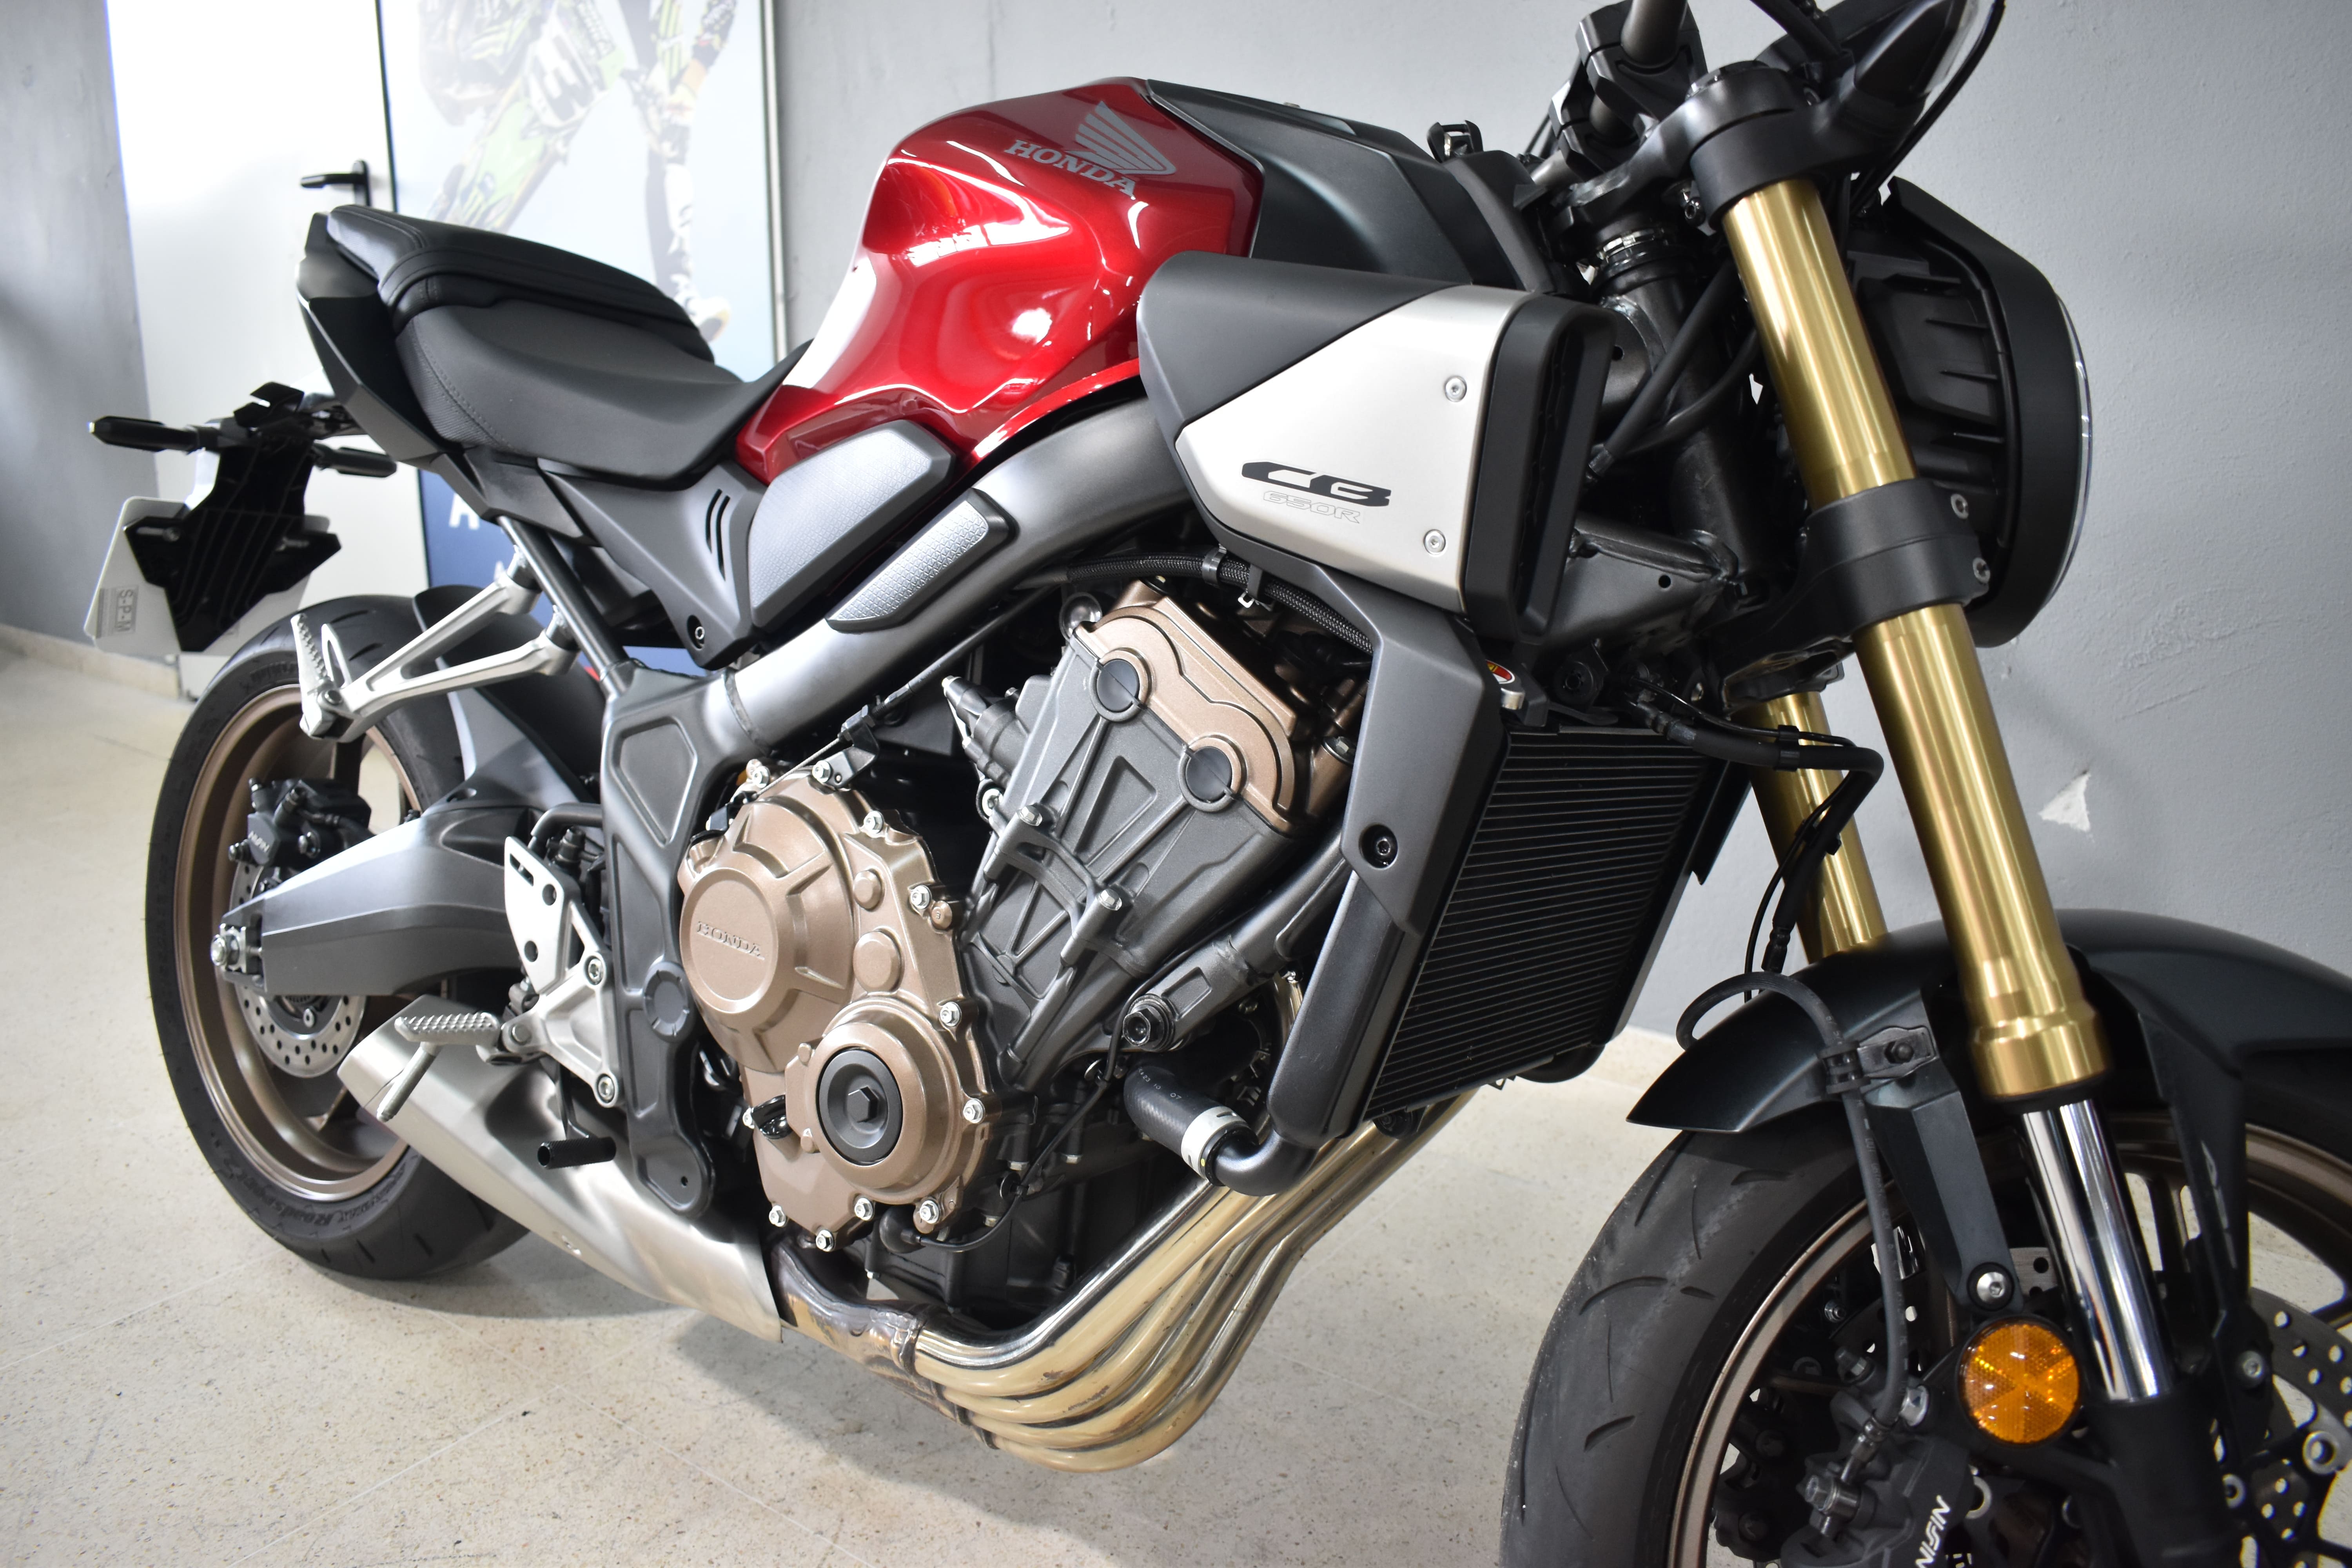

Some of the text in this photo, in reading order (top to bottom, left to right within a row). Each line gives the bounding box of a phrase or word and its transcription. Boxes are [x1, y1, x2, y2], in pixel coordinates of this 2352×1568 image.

[1004, 140, 1136, 196] HONDA
[1241, 462, 1391, 506] CB
[1263, 491, 1360, 523] 650R
[697, 921, 765, 960] HONDA
[1915, 1495, 1951, 1568] NISSIN
